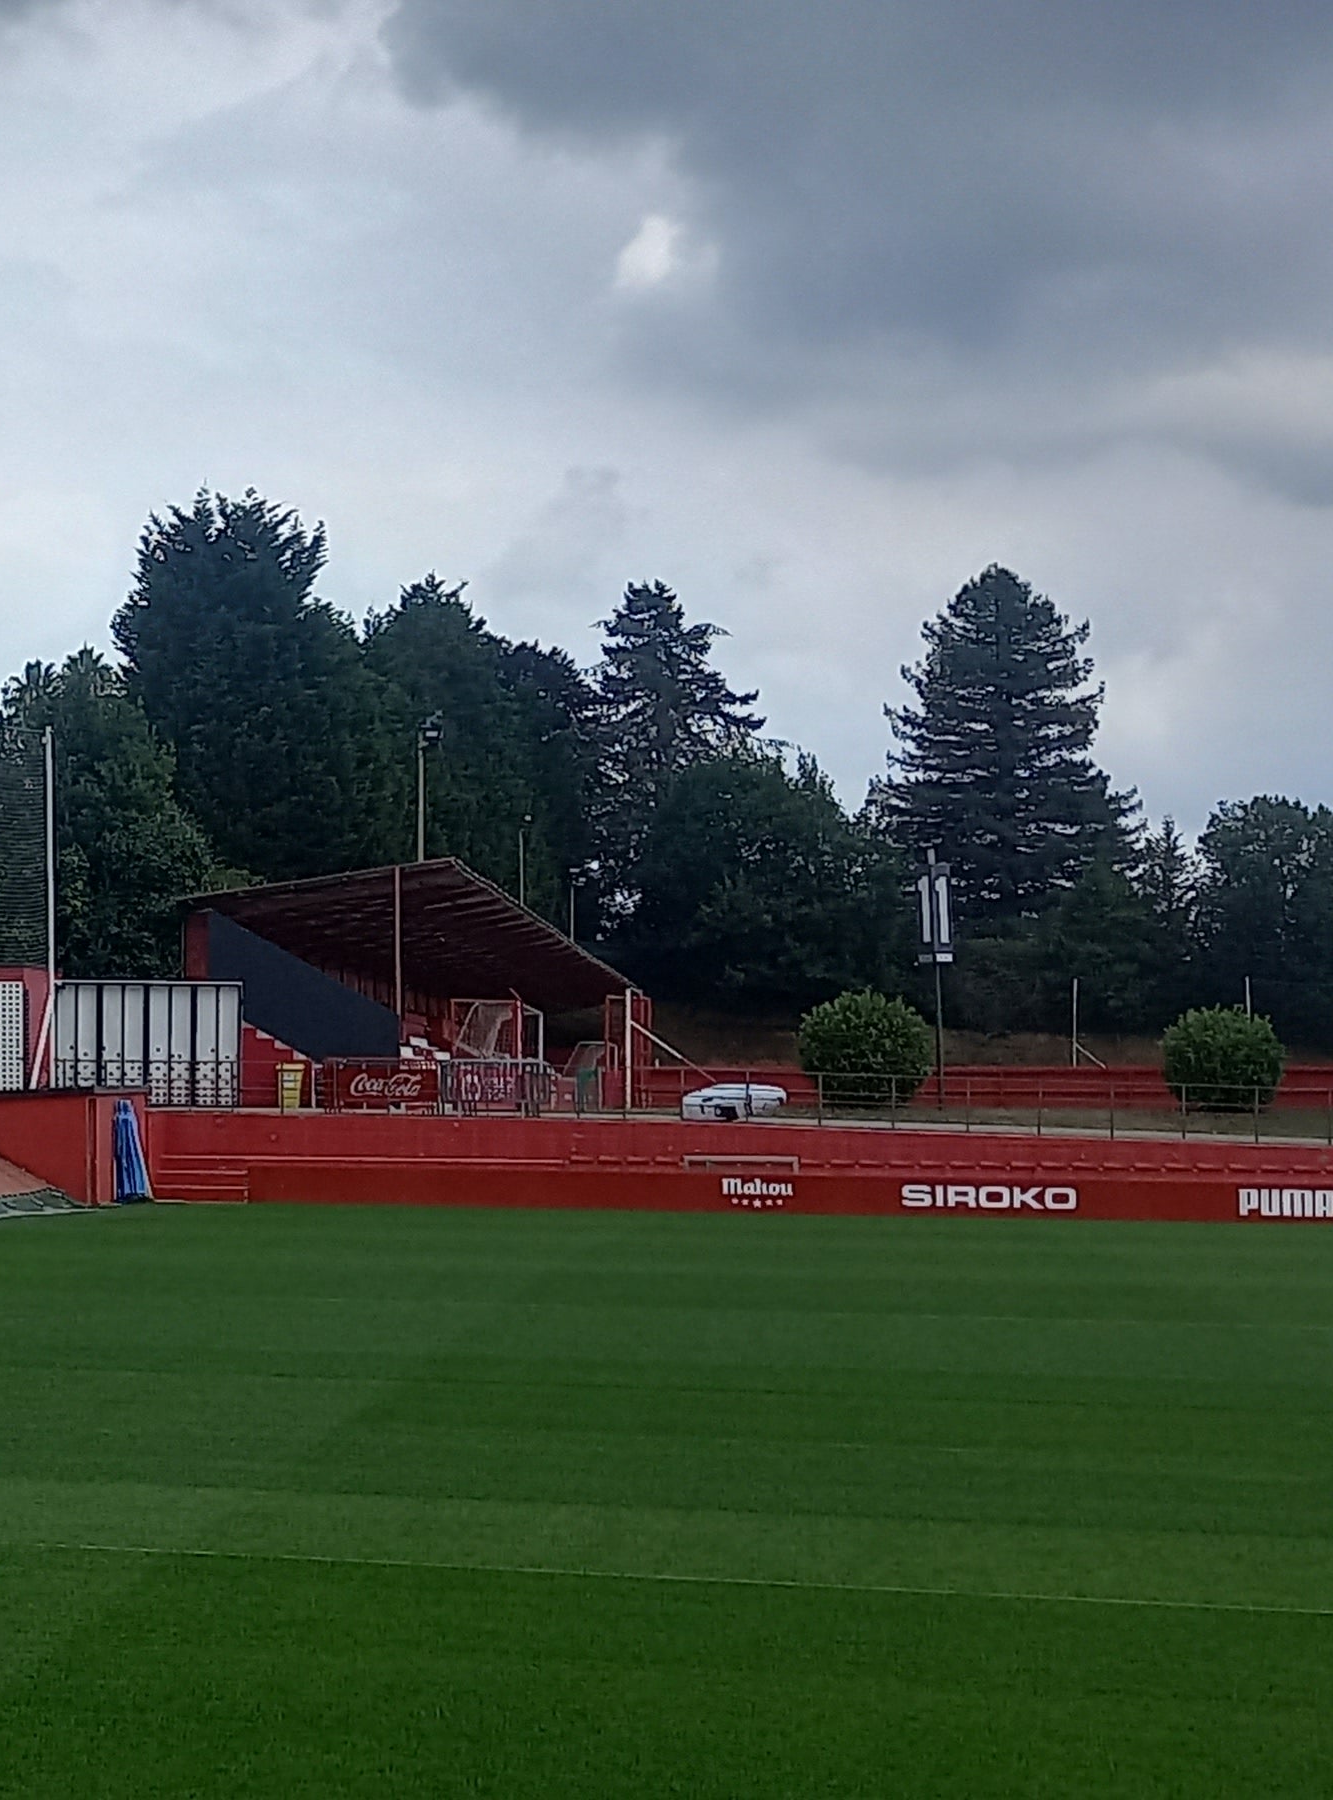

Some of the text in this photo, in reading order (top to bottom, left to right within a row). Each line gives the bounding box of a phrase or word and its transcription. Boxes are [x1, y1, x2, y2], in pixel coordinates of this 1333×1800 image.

[721, 1177, 1333, 1218] Mahou SIROKO PUMA
